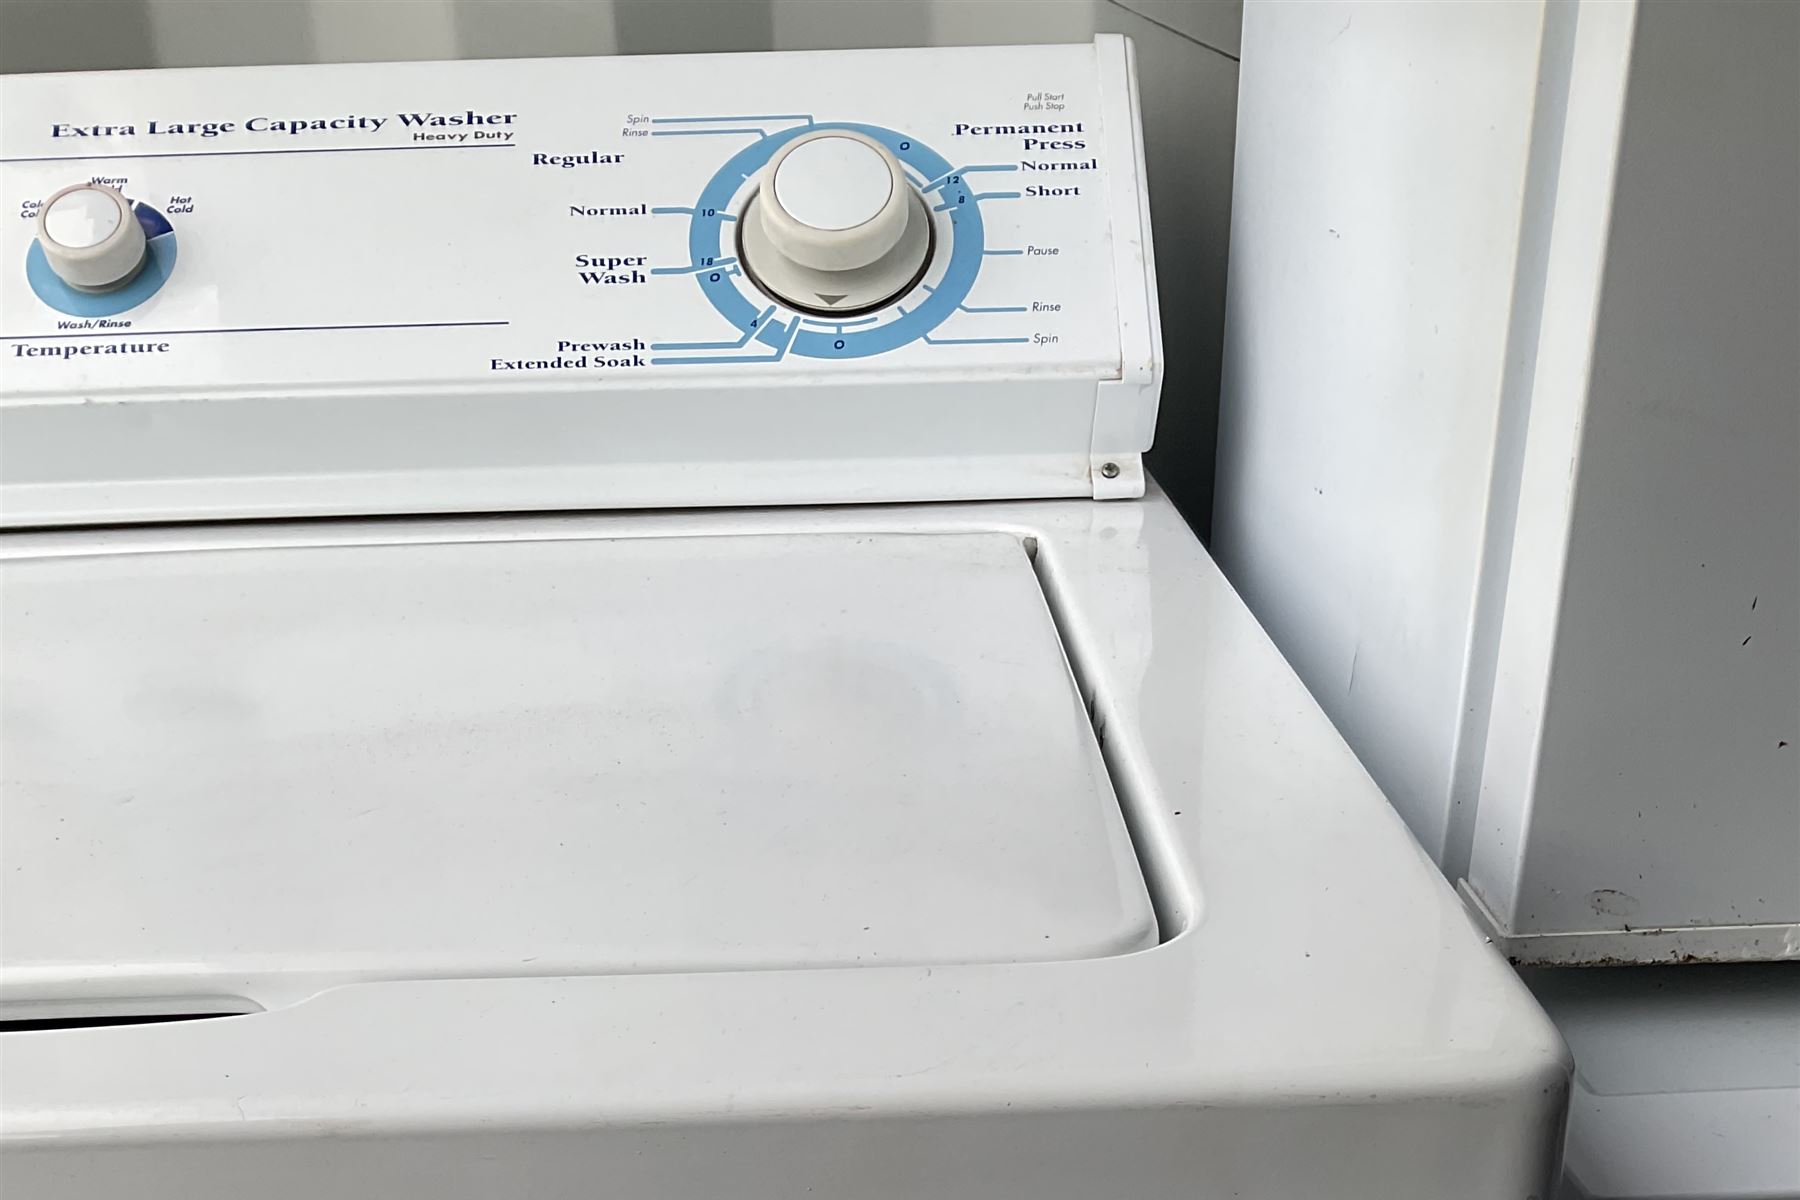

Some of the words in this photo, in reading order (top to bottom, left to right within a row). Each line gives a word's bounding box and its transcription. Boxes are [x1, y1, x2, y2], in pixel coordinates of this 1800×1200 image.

[1027, 92, 1042, 101] Pull
[1044, 92, 1065, 101] Start
[1023, 102, 1043, 111] Push
[1045, 102, 1065, 111] Stop
[51, 123, 135, 138] Extra
[147, 118, 236, 137] Large
[245, 115, 388, 135] Capacity
[397, 111, 518, 127] Washer
[626, 114, 649, 125] Spin
[622, 128, 649, 137] Rinse
[954, 122, 1085, 136] Permanent
[413, 131, 468, 142] Heavy
[474, 130, 514, 140] Duty
[1023, 138, 1086, 150] Press
[532, 151, 625, 168] Regular
[1021, 158, 1097, 171] Normal
[91, 176, 128, 185] Warm
[1025, 185, 1081, 197] Short
[22, 200, 44, 209] Col
[170, 196, 192, 205] Hot
[20, 210, 40, 219] Col
[166, 205, 194, 214] Cold
[569, 203, 647, 216] Normal
[702, 208, 715, 217] 10
[1027, 245, 1059, 256] Pause
[575, 255, 648, 270] Super
[701, 257, 714, 266] 18
[578, 271, 646, 284] Wash
[1032, 302, 1061, 312] Rinse
[57, 320, 132, 330] Wash/Rinse
[750, 319, 758, 328] 4
[1033, 333, 1059, 345] Spin
[11, 342, 170, 360] Temperature
[557, 339, 646, 352] Prewash
[490, 356, 587, 371] Extended
[593, 354, 646, 368] Soak
